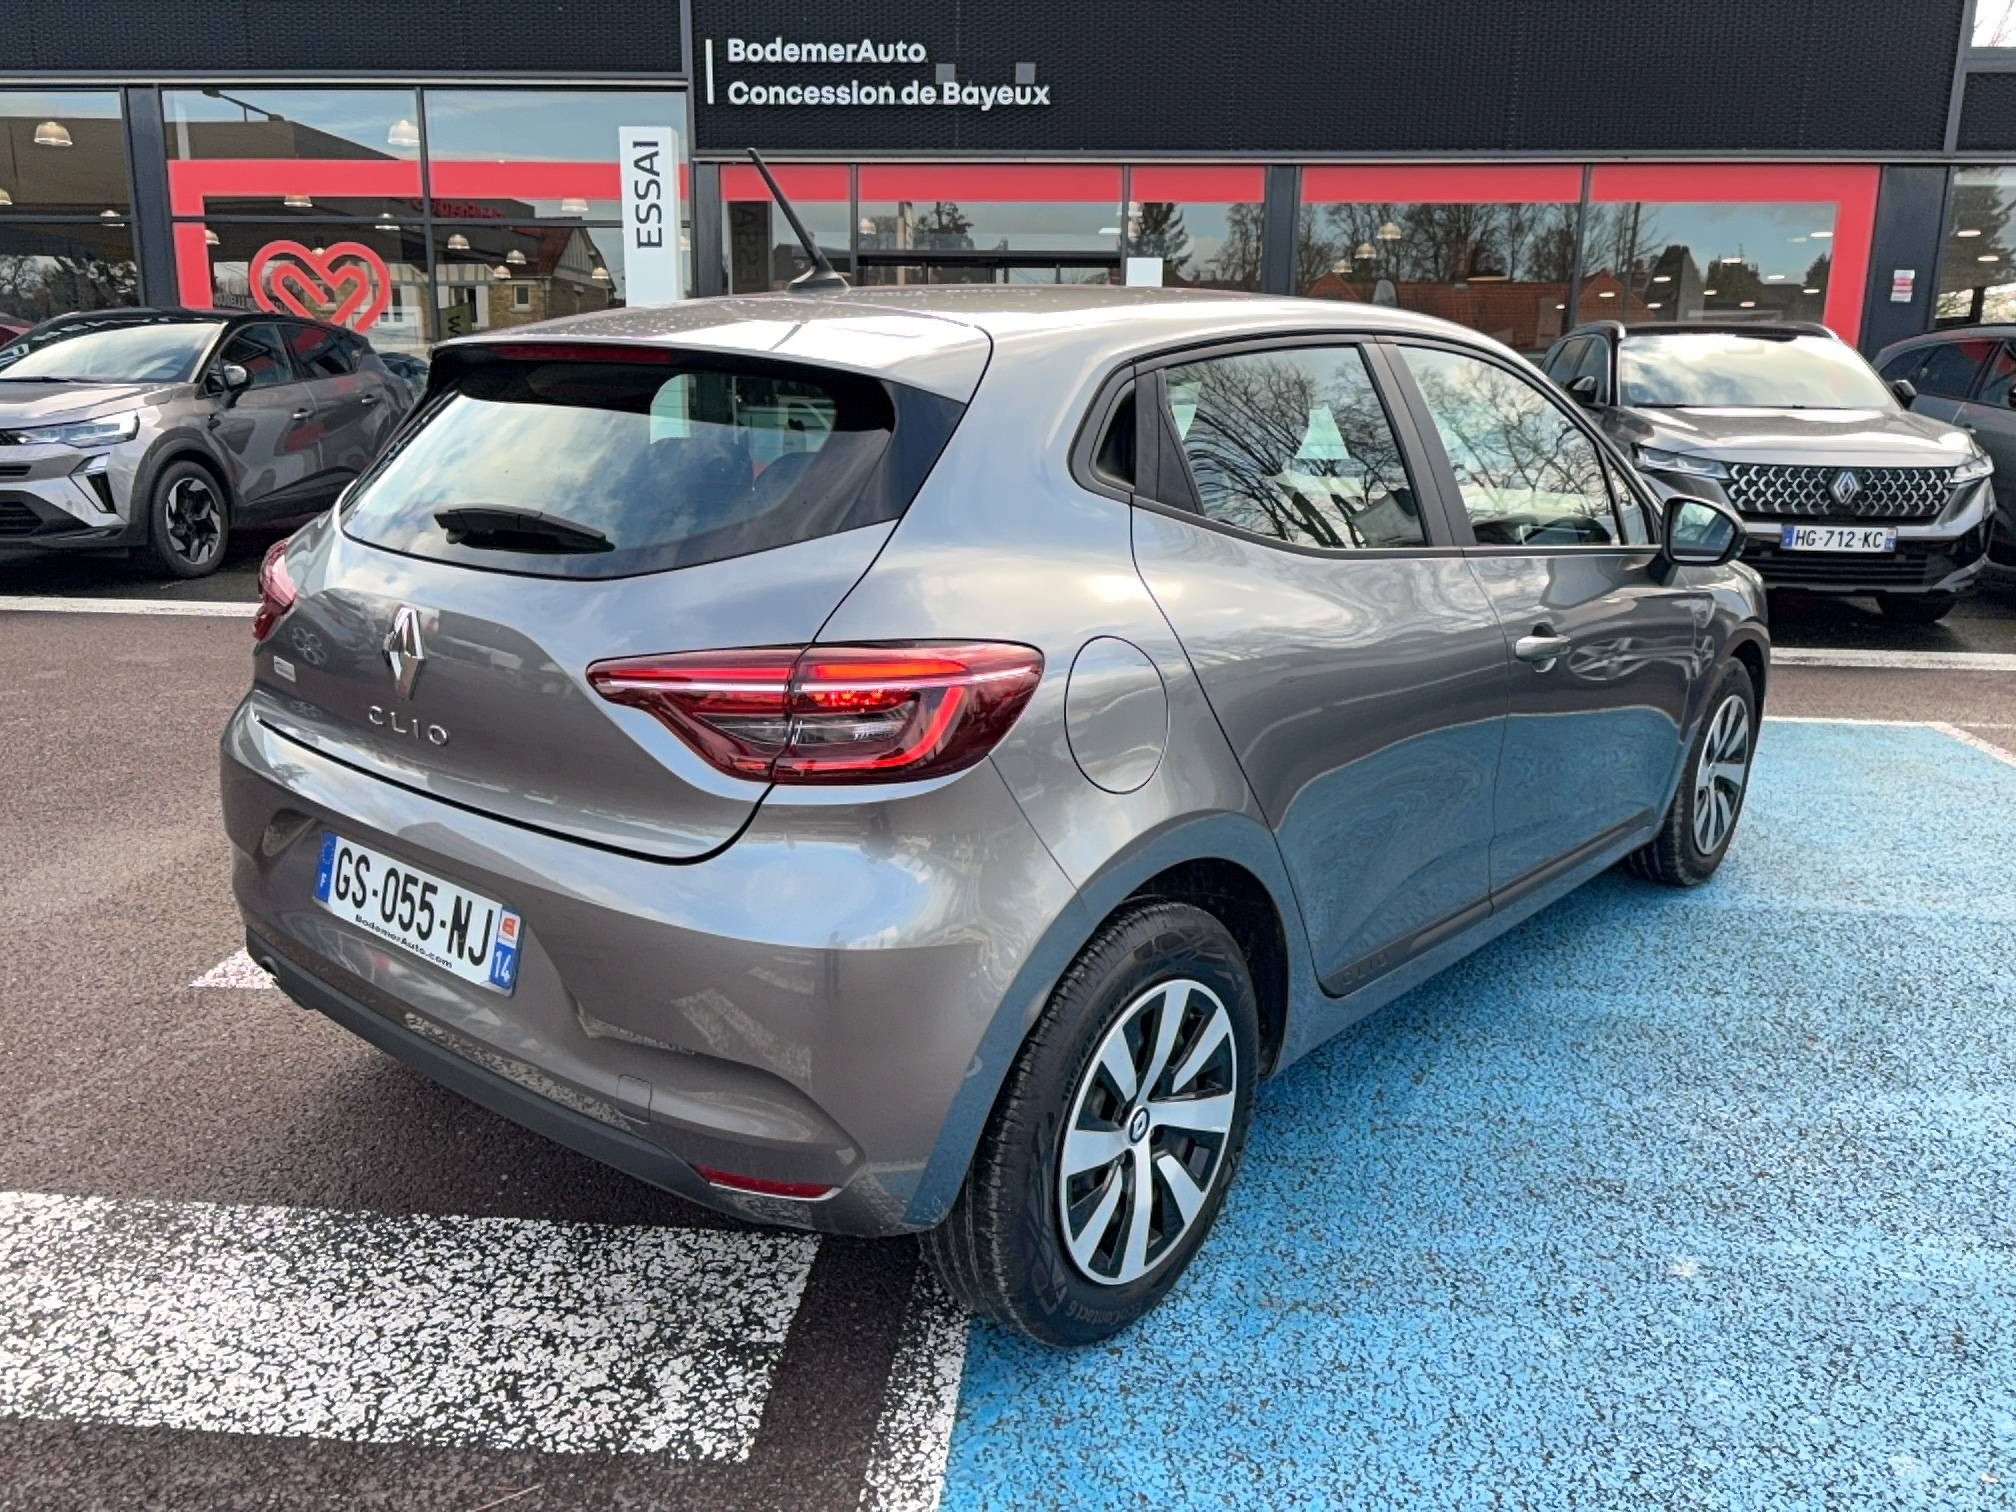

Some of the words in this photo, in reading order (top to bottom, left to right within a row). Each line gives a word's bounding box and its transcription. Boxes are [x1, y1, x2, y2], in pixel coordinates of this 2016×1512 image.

[728, 37, 926, 63] BodemerAuto
[728, 80, 895, 105] Concession
[901, 80, 937, 105] de
[942, 82, 1050, 111] Bayeux
[633, 141, 662, 248] ESSAI
[1794, 529, 1884, 549] HG-712-KC
[368, 705, 448, 745] CLIO
[335, 847, 493, 966] GS-055-NJ
[355, 914, 452, 968] BodemerAuto.com
[494, 950, 511, 982] 14
